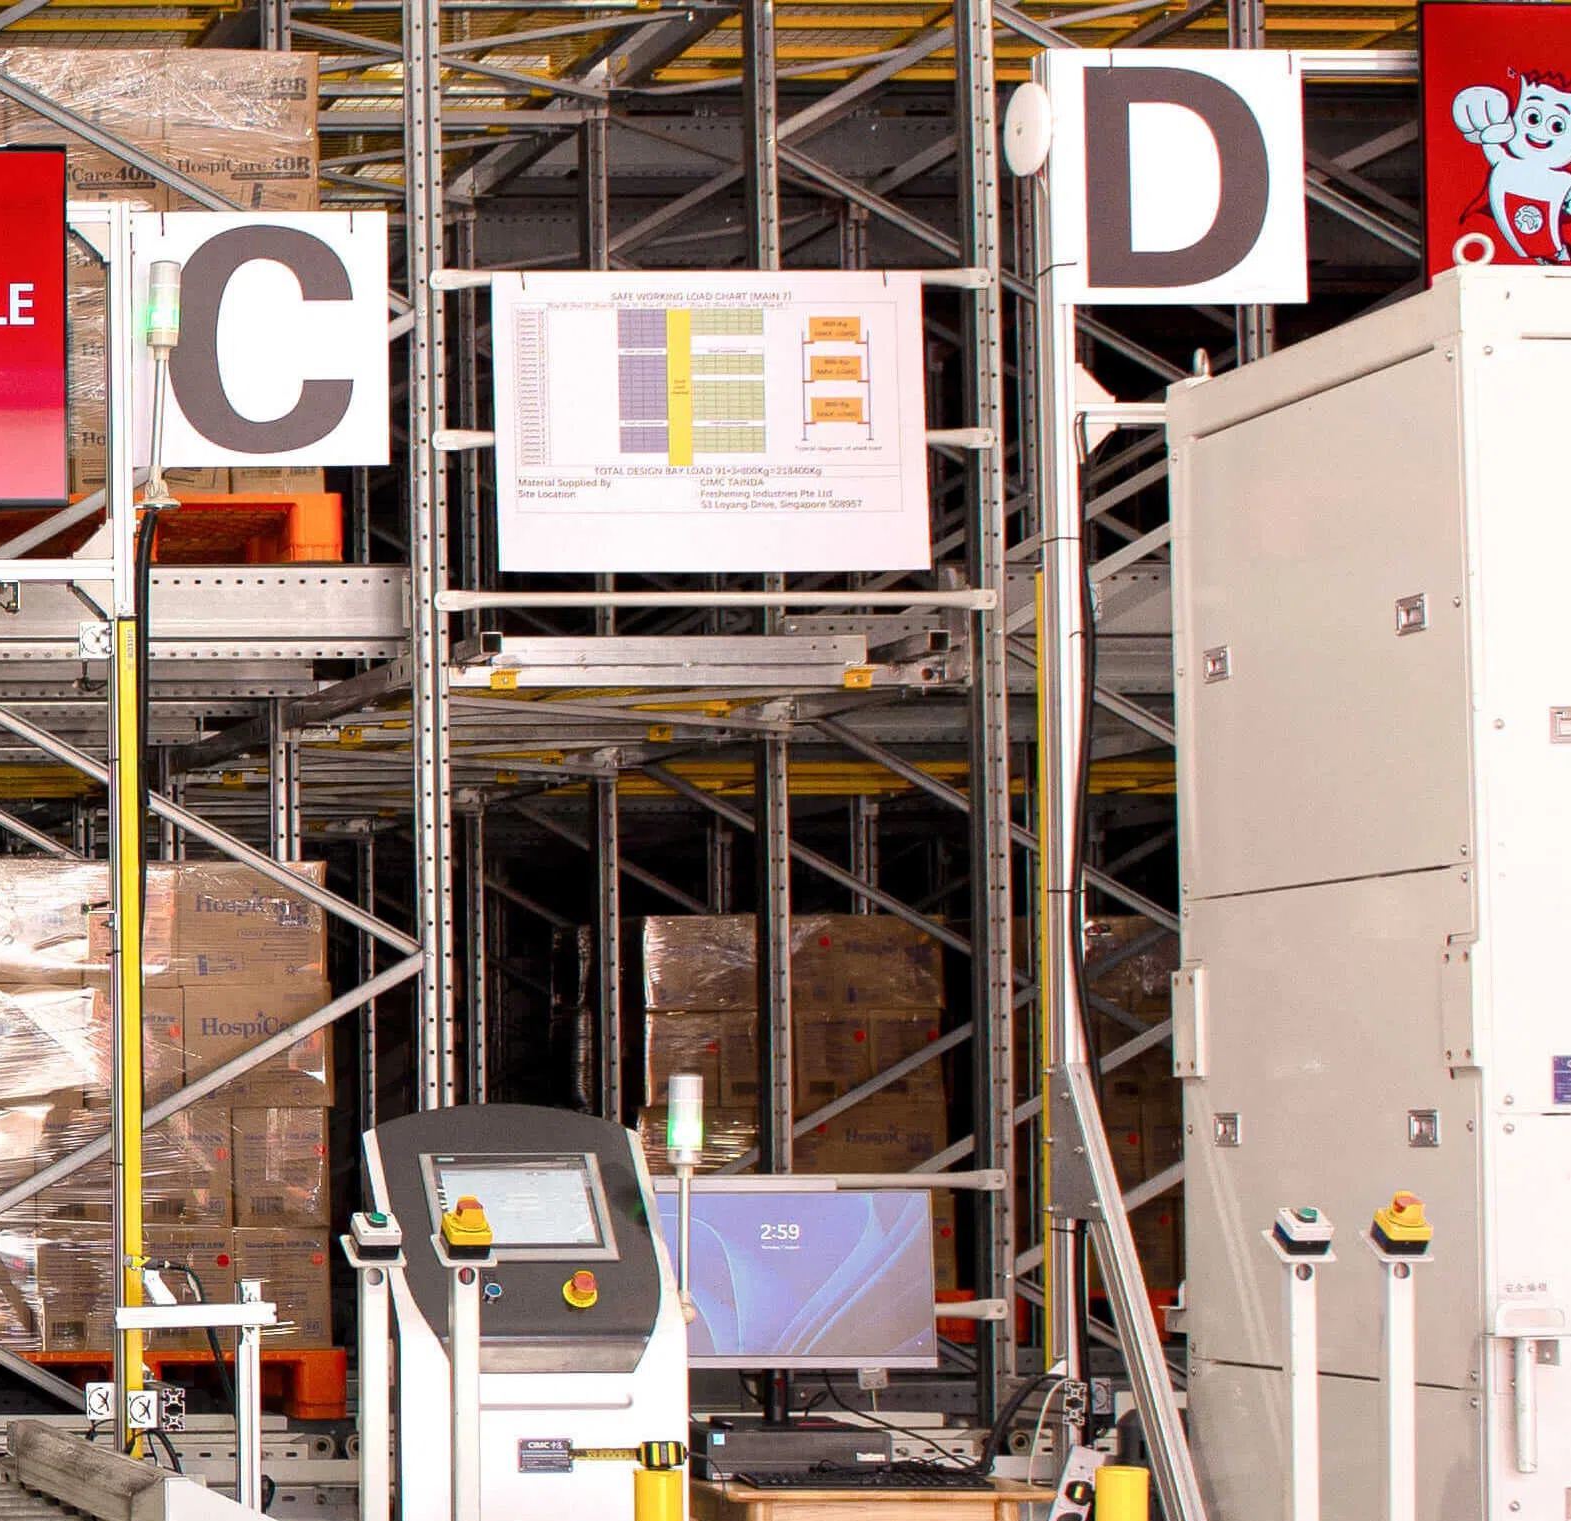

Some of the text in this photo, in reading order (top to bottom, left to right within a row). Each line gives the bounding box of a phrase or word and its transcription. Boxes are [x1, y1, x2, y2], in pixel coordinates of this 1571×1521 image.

[177, 152, 267, 174] HospiCare
[1085, 65, 1269, 288] D
[610, 291, 633, 301] SAFE
[637, 291, 684, 301] WORKING
[686, 291, 713, 301] LOAD
[714, 291, 747, 301] CHART
[166, 224, 354, 454] C
[594, 467, 625, 477] TOTAL
[518, 477, 555, 488] Material
[557, 477, 597, 489] Supplied
[518, 489, 577, 499] Site Location
[760, 1222, 800, 1241] 2:59
